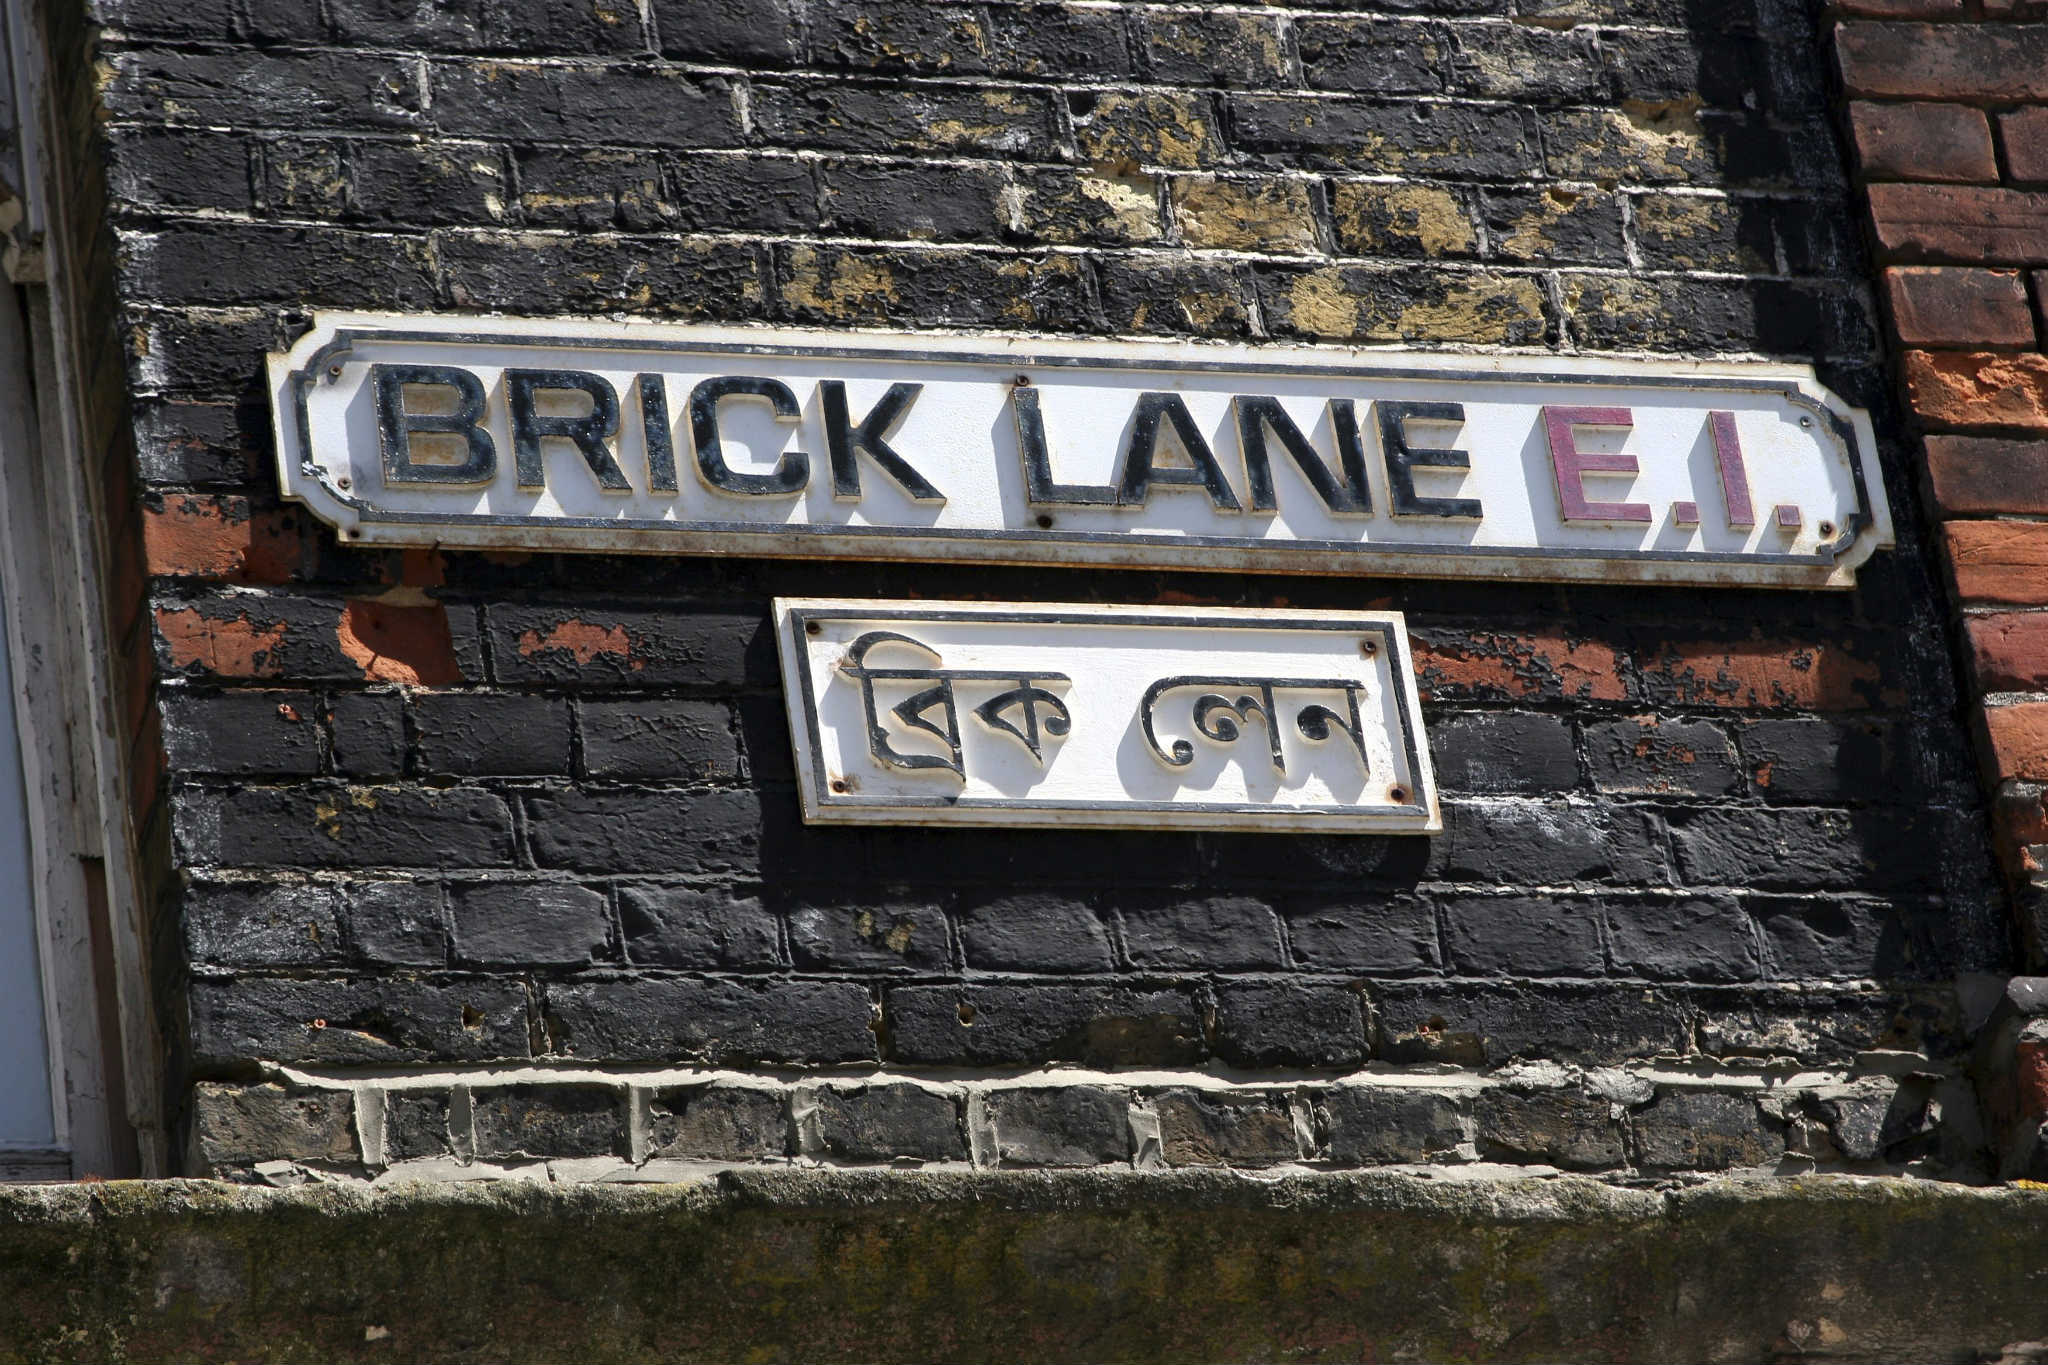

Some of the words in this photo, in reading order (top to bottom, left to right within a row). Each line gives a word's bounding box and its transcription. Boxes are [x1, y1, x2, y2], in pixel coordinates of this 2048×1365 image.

[371, 362, 946, 505] BRICK
[1010, 386, 1483, 522] LANE
[838, 631, 1072, 787] ব্রিক
[1140, 675, 1370, 778] লেন
